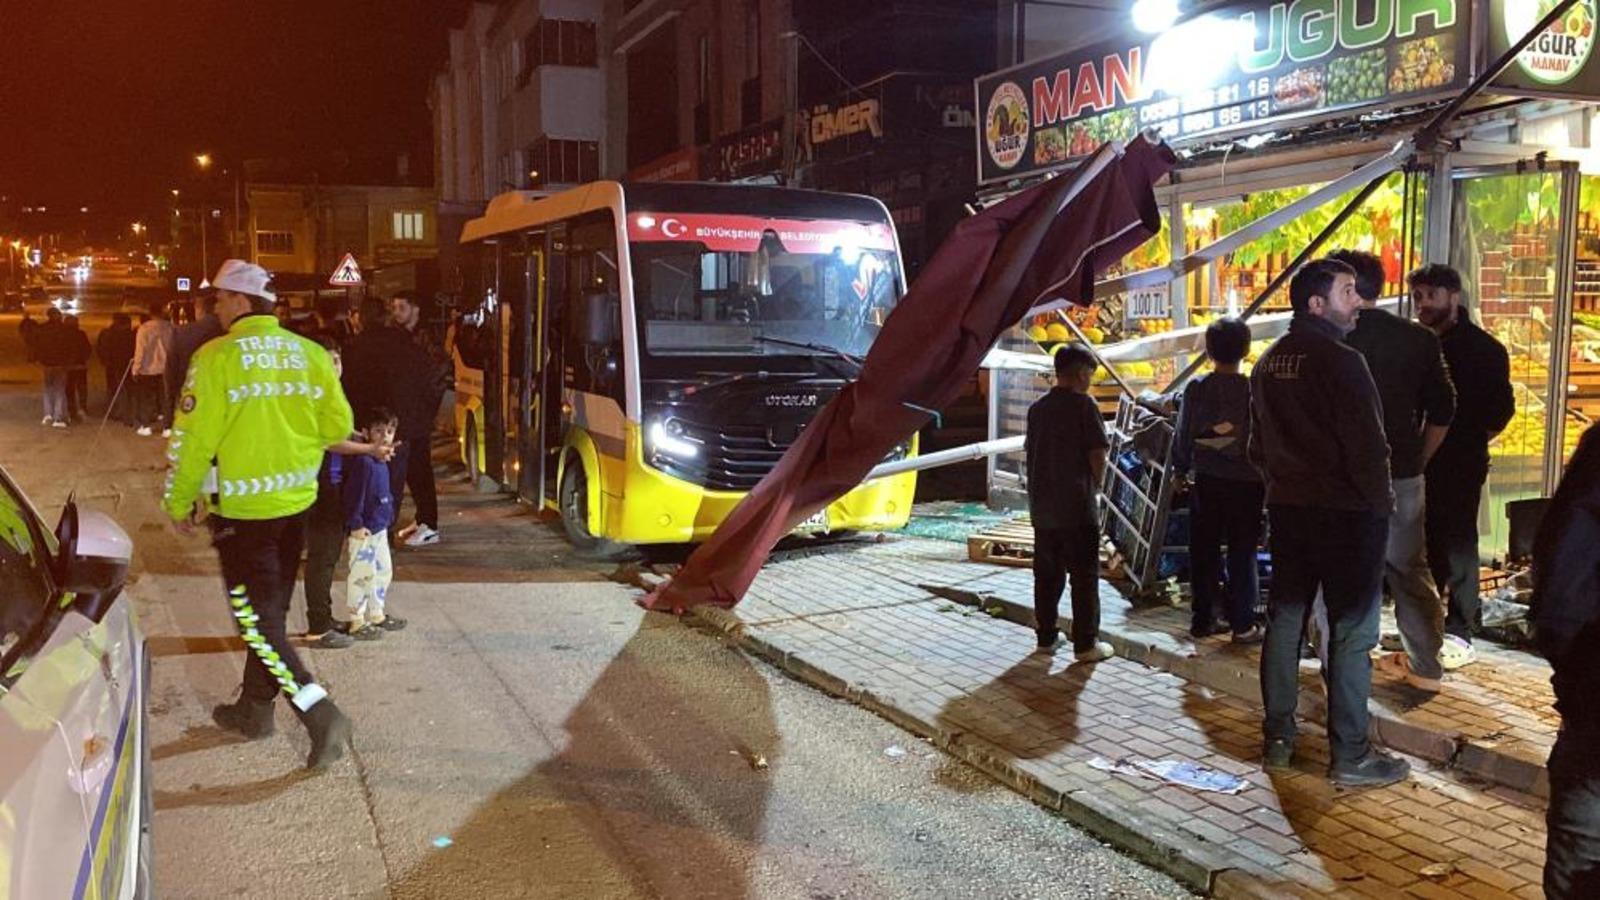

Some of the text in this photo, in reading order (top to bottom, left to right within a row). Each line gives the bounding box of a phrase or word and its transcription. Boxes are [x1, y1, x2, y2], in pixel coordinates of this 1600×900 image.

[1531, 56, 1571, 72] MANAV
[1248, 77, 1270, 96] 16
[1248, 101, 1269, 119] 13
[811, 99, 882, 143] ÖMER
[1132, 292, 1165, 315] 100 TL
[242, 352, 306, 370] POLİS
[766, 394, 818, 406] OTOKAR
